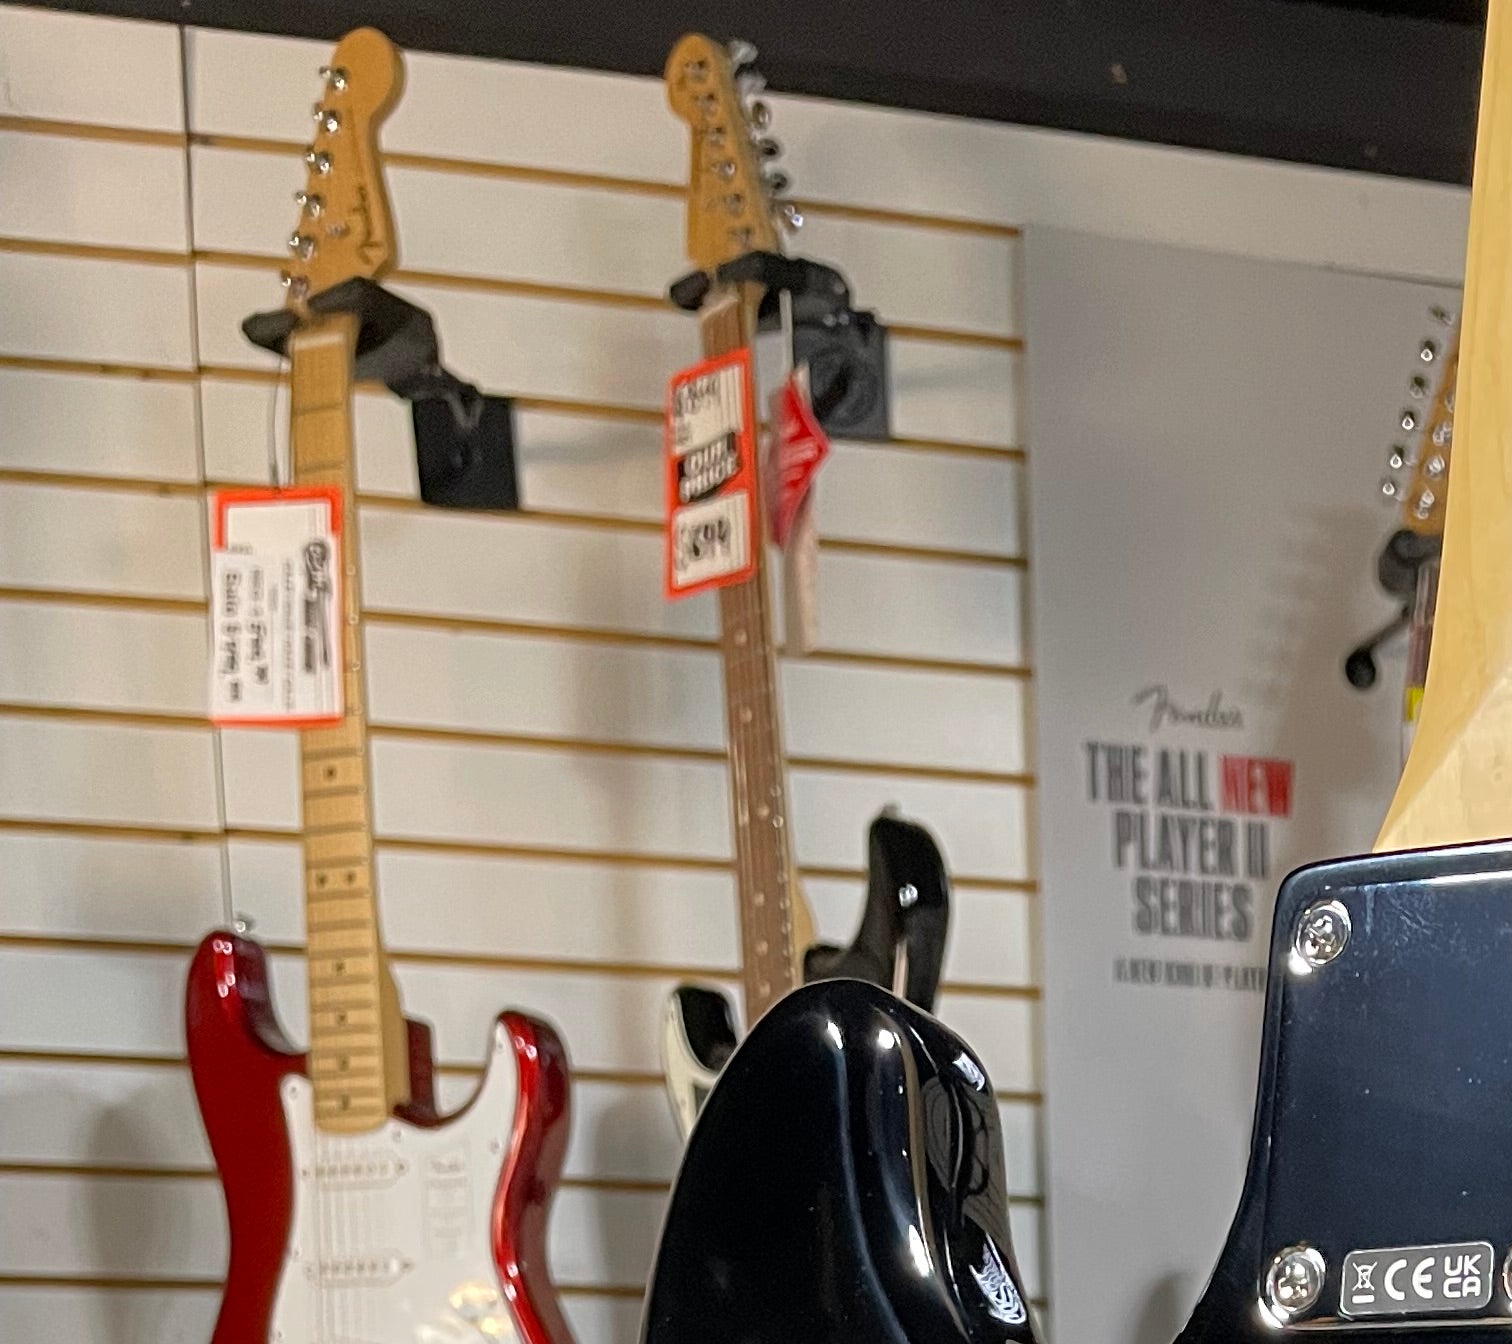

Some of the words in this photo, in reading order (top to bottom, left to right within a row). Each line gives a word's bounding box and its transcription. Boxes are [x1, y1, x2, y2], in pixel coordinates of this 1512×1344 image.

[1131, 684, 1245, 730] Fender
[1083, 741, 1148, 804] THE
[1152, 748, 1213, 810] ALL
[1221, 756, 1291, 817] NEW
[1112, 809, 1237, 877] PLAYER
[1245, 820, 1269, 879] II
[1133, 876, 1253, 941] SERIES
[1383, 1257, 1436, 1301] CE
[1442, 1277, 1481, 1299] CA
[1443, 1253, 1482, 1277] UK
